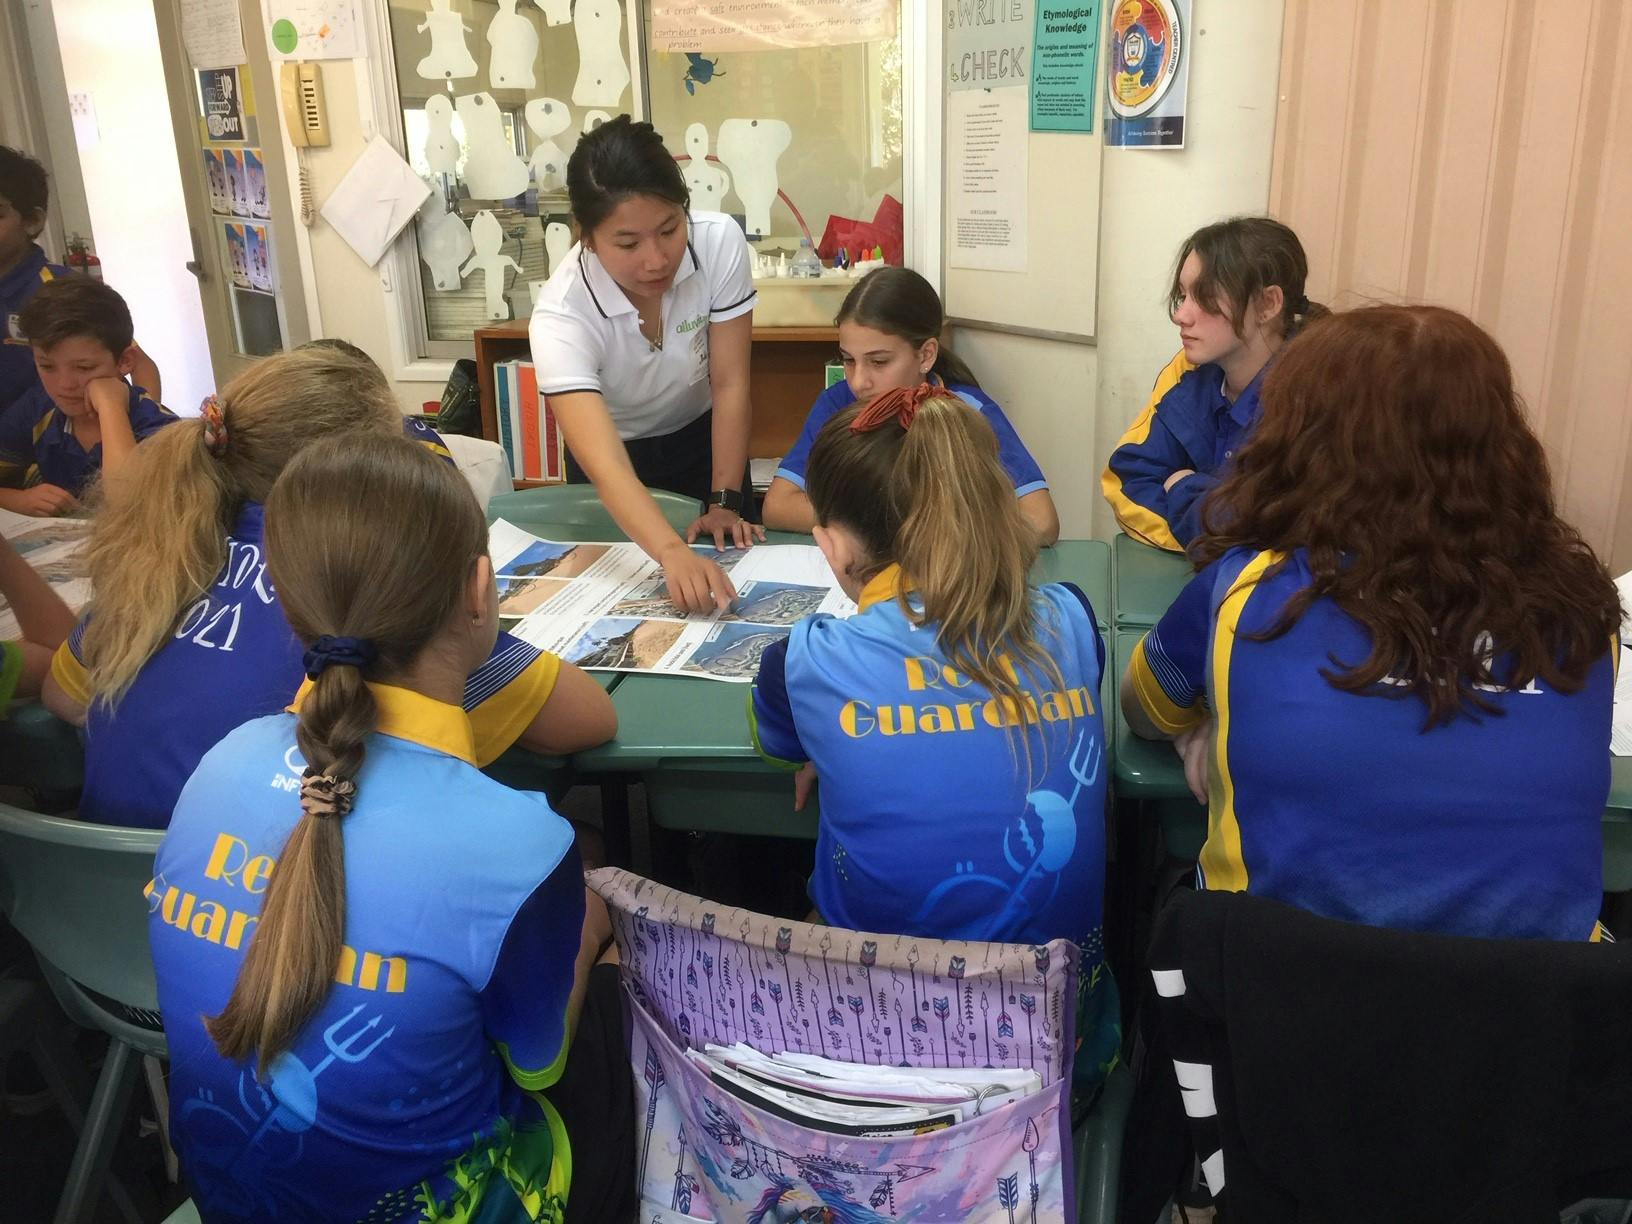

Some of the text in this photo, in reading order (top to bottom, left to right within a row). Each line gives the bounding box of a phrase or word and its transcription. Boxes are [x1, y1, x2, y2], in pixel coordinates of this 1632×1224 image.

[957, 0, 1024, 27] WRITE
[1043, 8, 1092, 21] Etymological
[1045, 23, 1087, 33] Knowledge
[960, 46, 1025, 82] CHECK
[222, 116, 239, 133] OUT
[204, 832, 276, 894] Re
